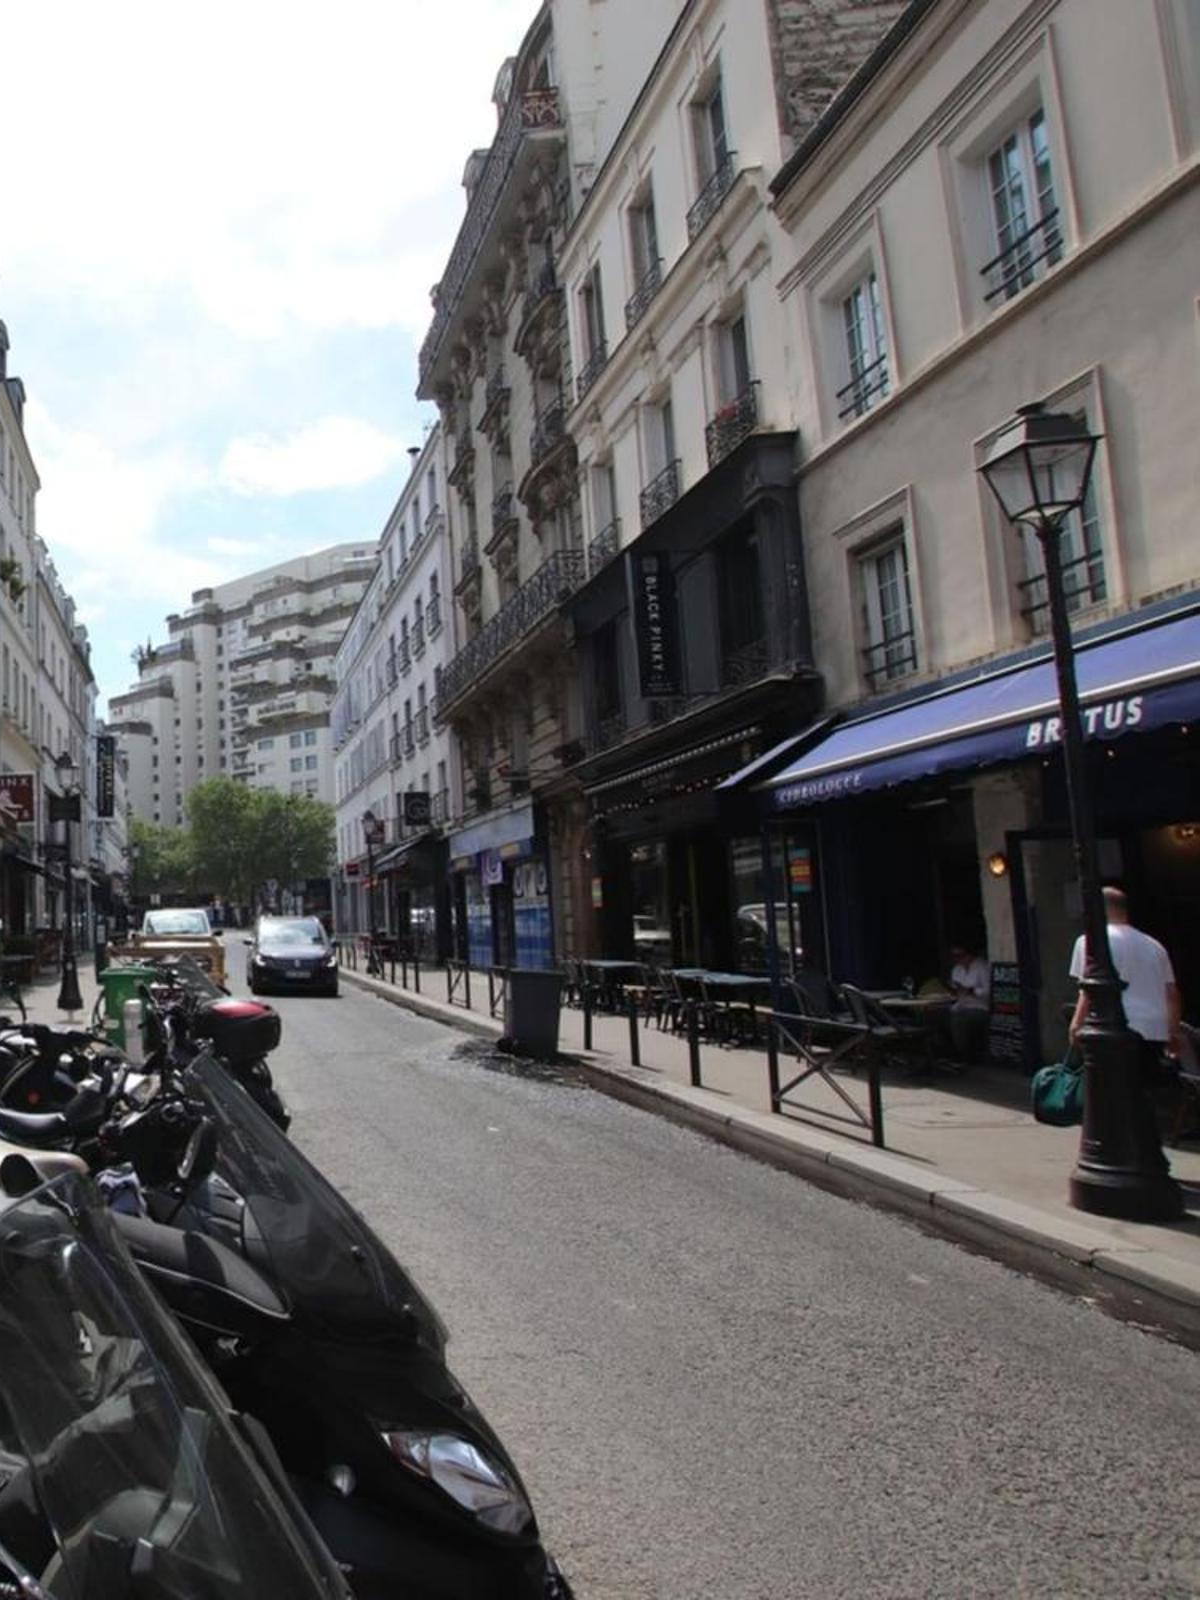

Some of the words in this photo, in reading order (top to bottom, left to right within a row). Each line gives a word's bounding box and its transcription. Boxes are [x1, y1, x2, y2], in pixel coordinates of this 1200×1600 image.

[645, 575, 659, 622] BLACK
[650, 626, 664, 672] PINKY
[1026, 696, 1143, 747] BRTUS
